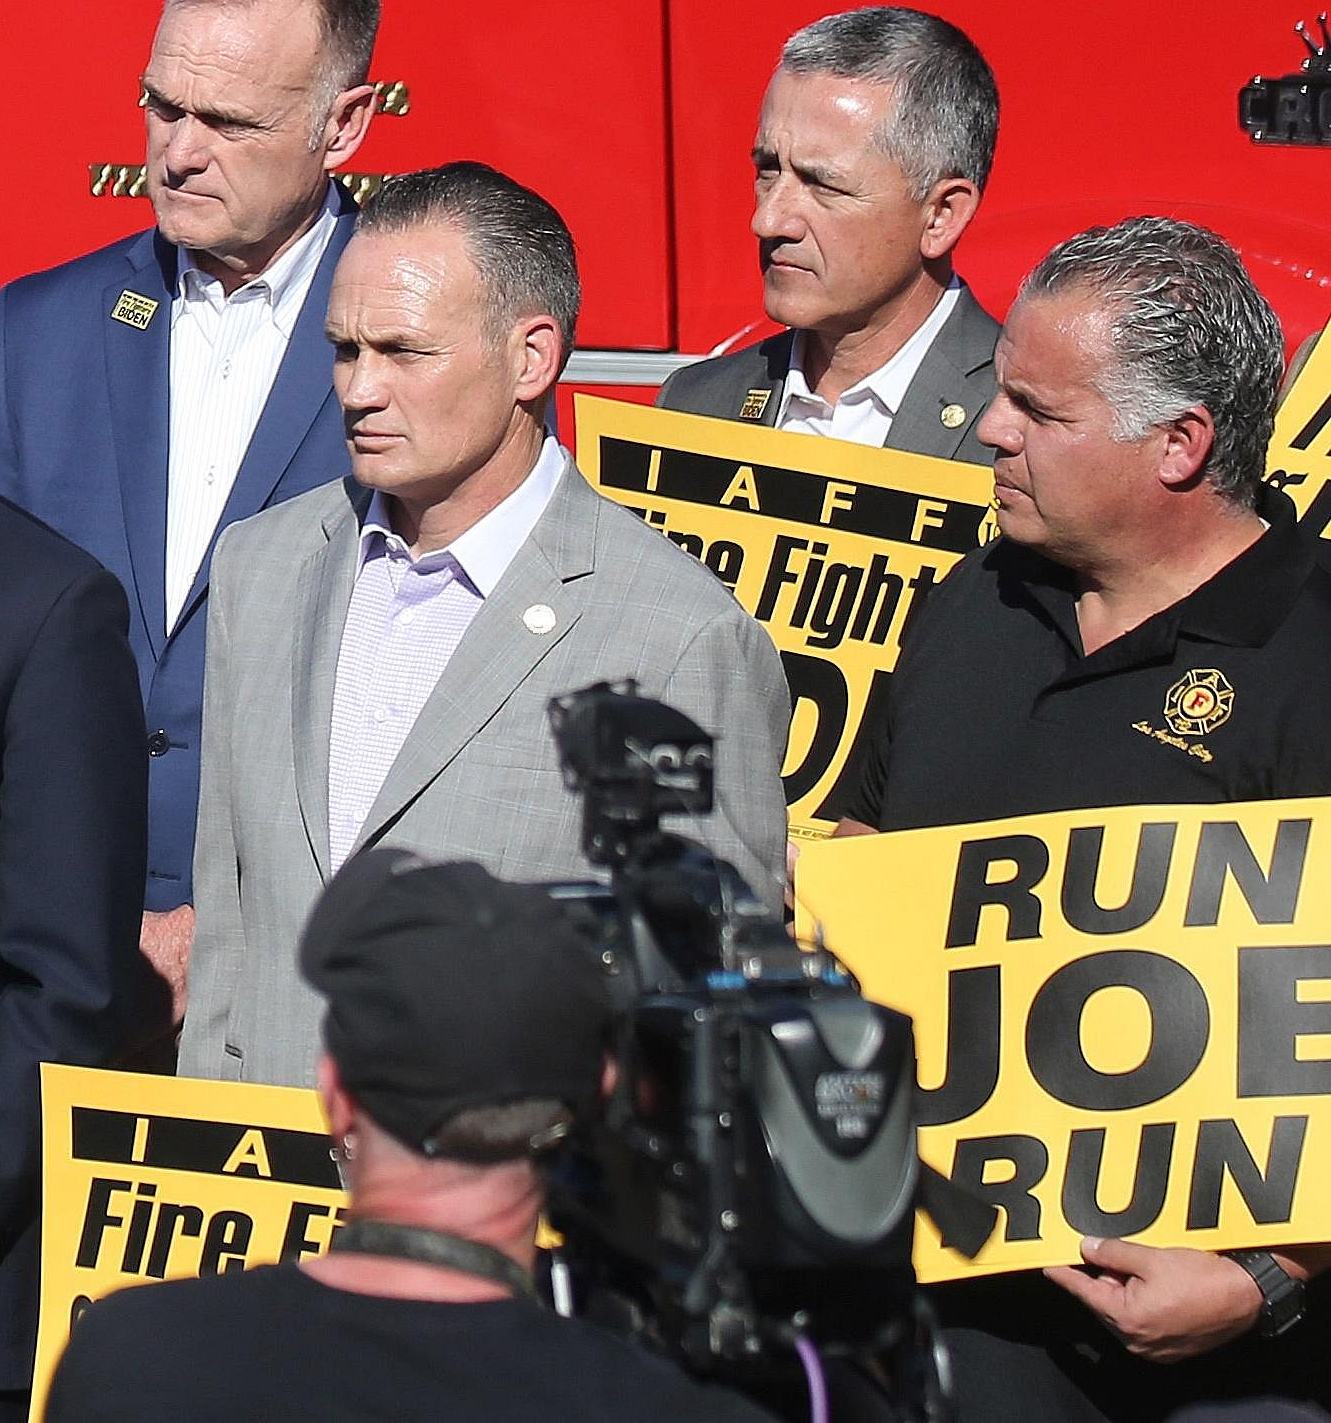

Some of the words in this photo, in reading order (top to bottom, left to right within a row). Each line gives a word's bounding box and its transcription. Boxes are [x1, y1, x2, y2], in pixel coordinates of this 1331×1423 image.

[944, 817, 1314, 950] RUN
[915, 944, 1331, 1128] JOE
[74, 1176, 254, 1279] Fire
[939, 1114, 1310, 1244] RUN
